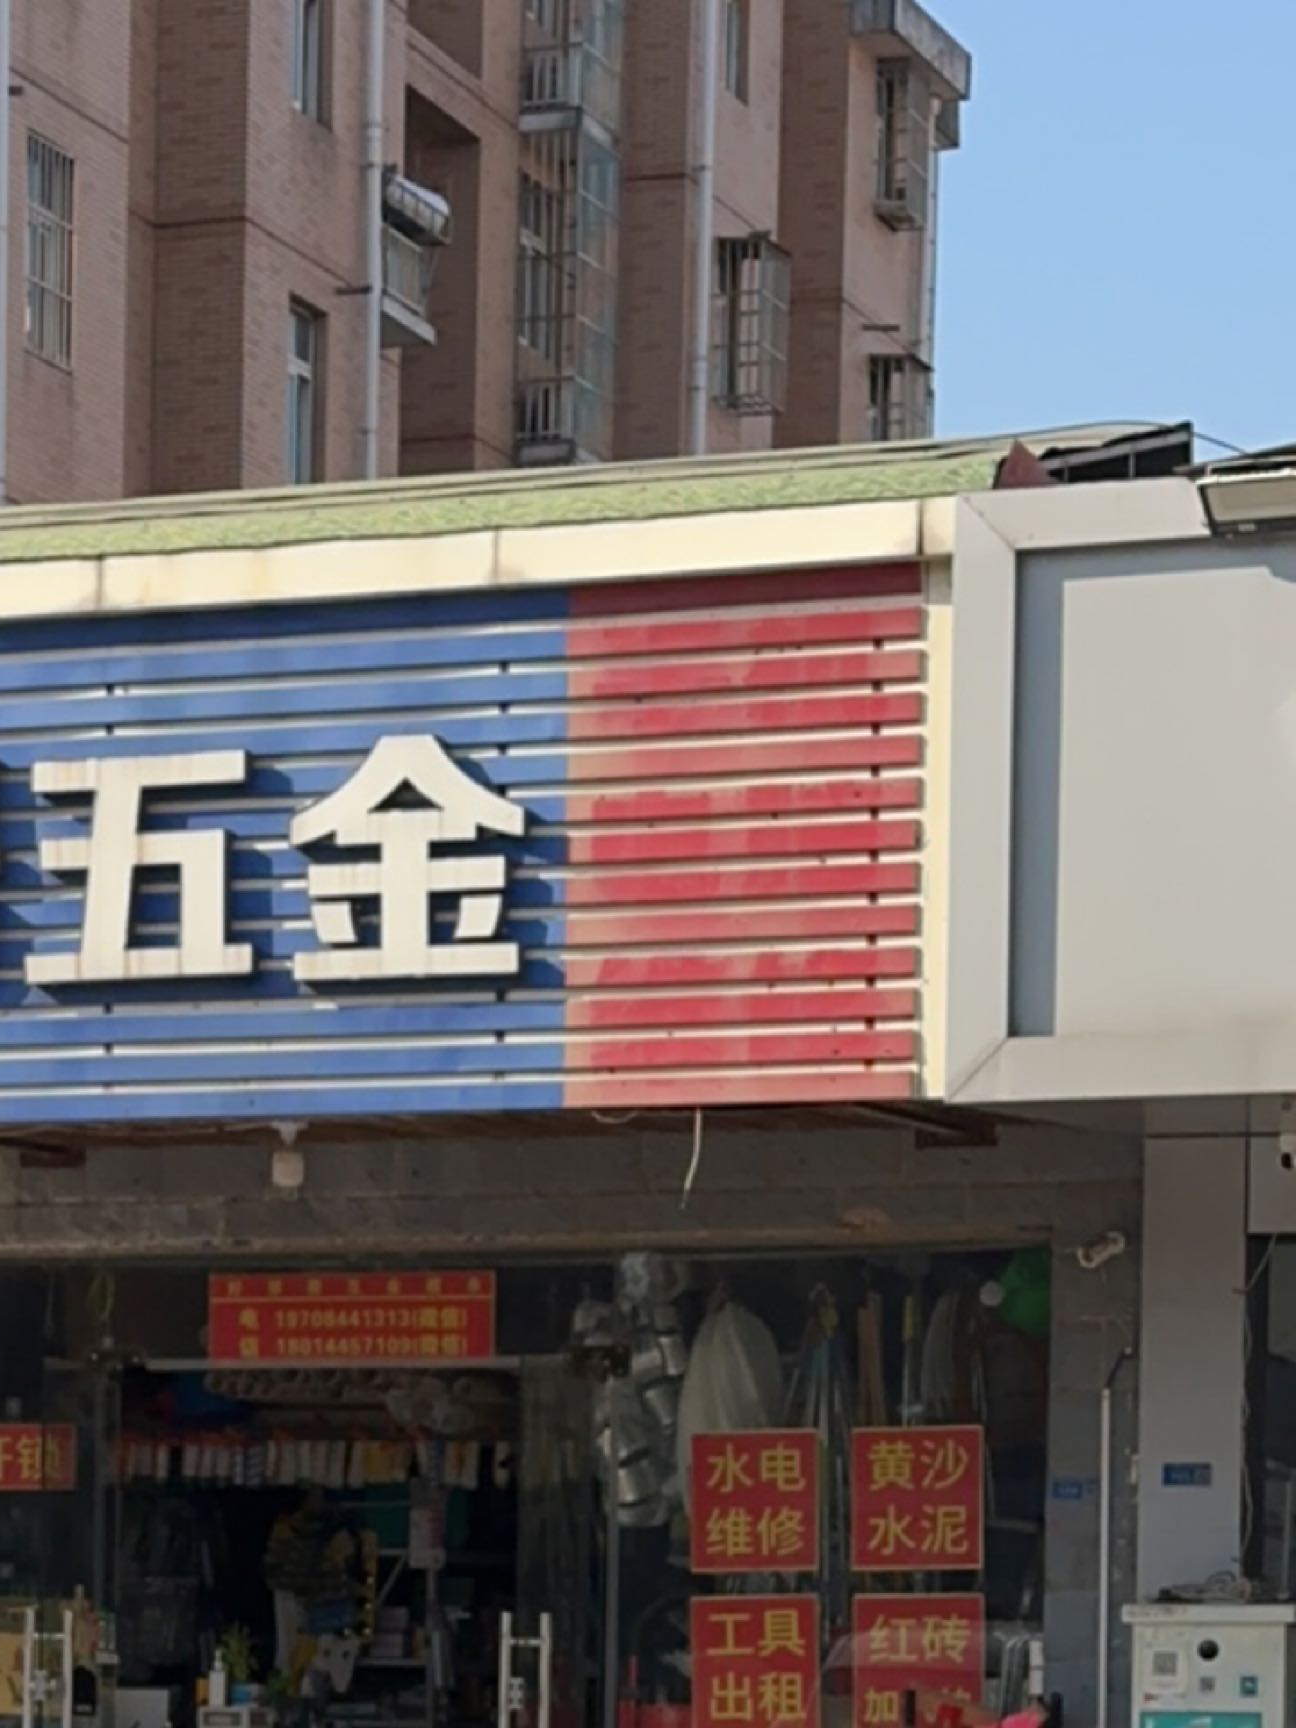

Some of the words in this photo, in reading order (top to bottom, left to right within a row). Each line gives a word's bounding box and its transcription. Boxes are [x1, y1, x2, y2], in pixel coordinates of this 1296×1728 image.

[705, 1442, 806, 1494] 水电
[867, 1439, 970, 1492] 黄沙
[705, 1505, 806, 1558] 维修
[866, 1503, 969, 1556] 水泥
[705, 1608, 807, 1657] 工具
[868, 1614, 972, 1664] 红砖
[708, 1671, 807, 1723] 出租
